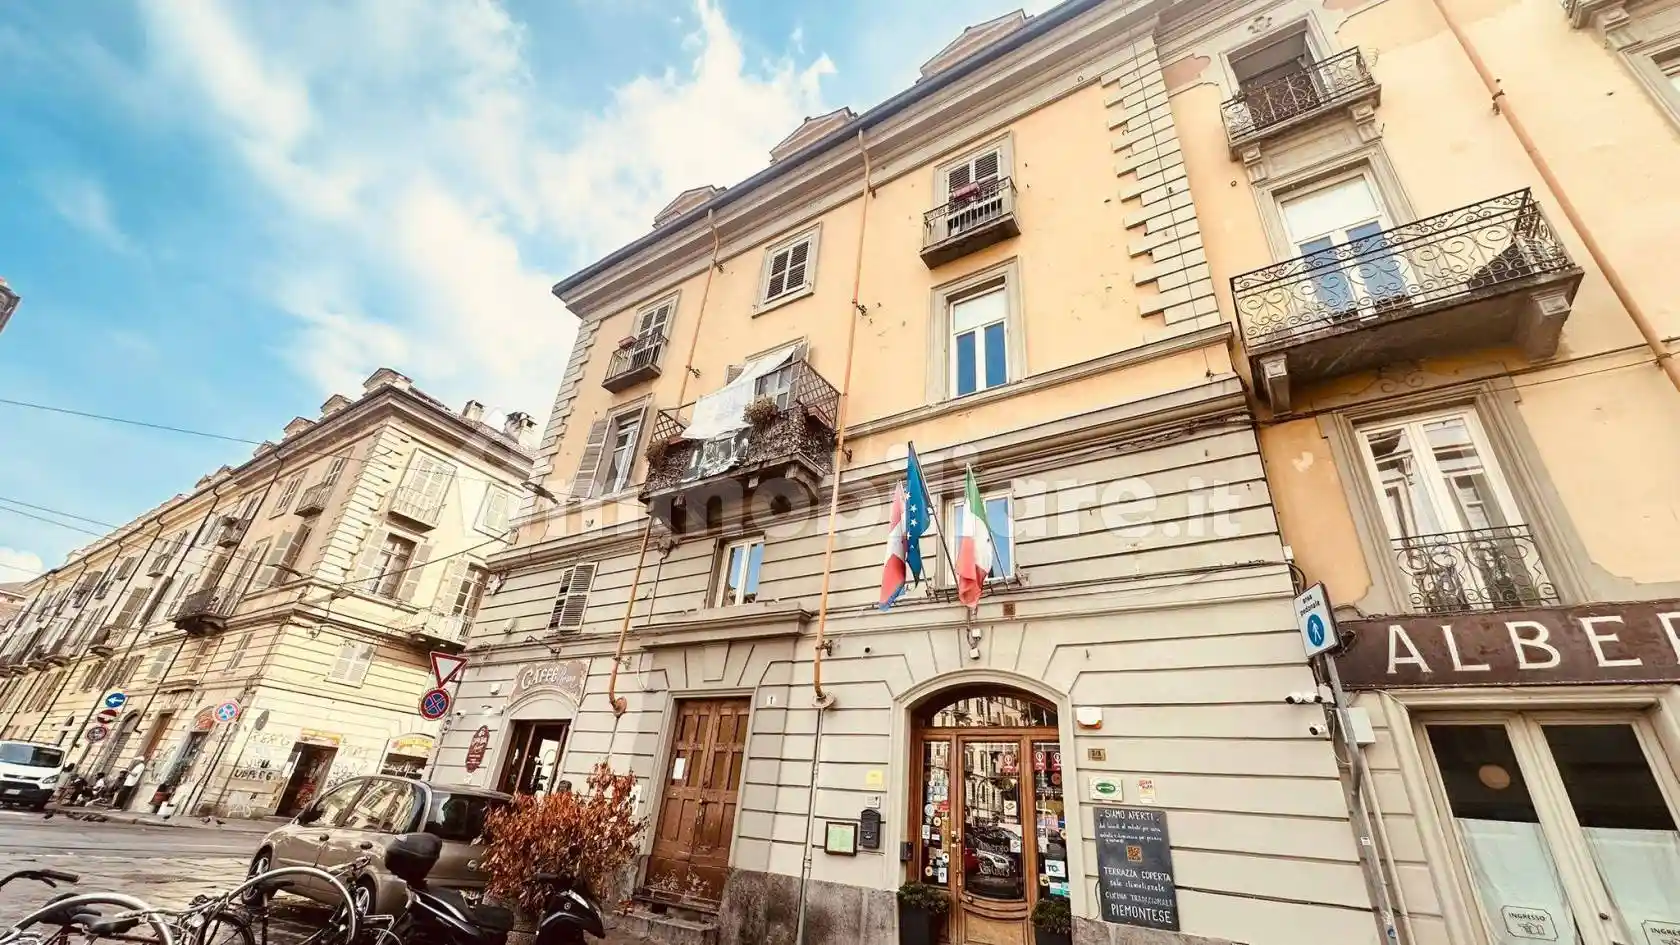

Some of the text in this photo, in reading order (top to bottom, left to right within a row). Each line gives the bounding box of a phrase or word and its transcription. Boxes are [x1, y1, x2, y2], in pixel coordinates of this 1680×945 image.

[1104, 809, 1154, 821] SIAMO APERTI
[1103, 866, 1172, 882] TERRAZZA COPERTA
[1111, 903, 1172, 924] PIEMONTESE
[1508, 911, 1546, 922] INGRESSO
